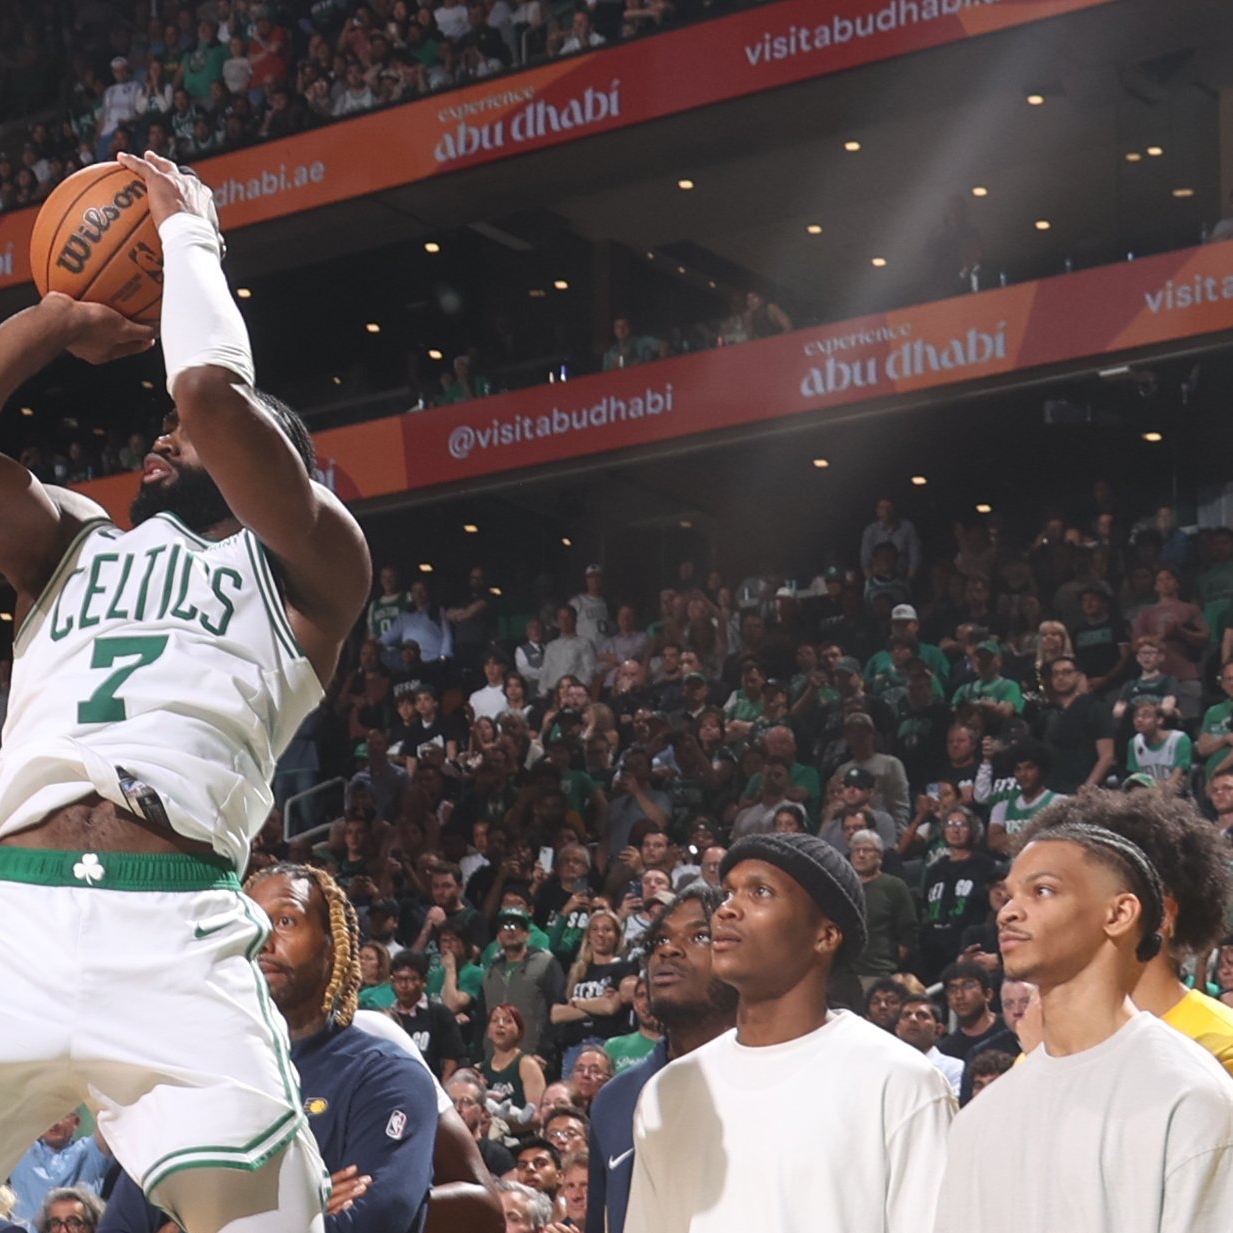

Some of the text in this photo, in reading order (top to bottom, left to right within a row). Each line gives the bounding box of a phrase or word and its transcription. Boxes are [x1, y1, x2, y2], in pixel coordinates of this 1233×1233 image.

[434, 79, 621, 162] abu dhabi
[56, 180, 148, 275] Wilson
[799, 320, 1008, 398] abu dhabi
[448, 384, 673, 459] @visitabudhabi
[50, 544, 242, 642] CELTICS
[77, 634, 170, 724] 7
